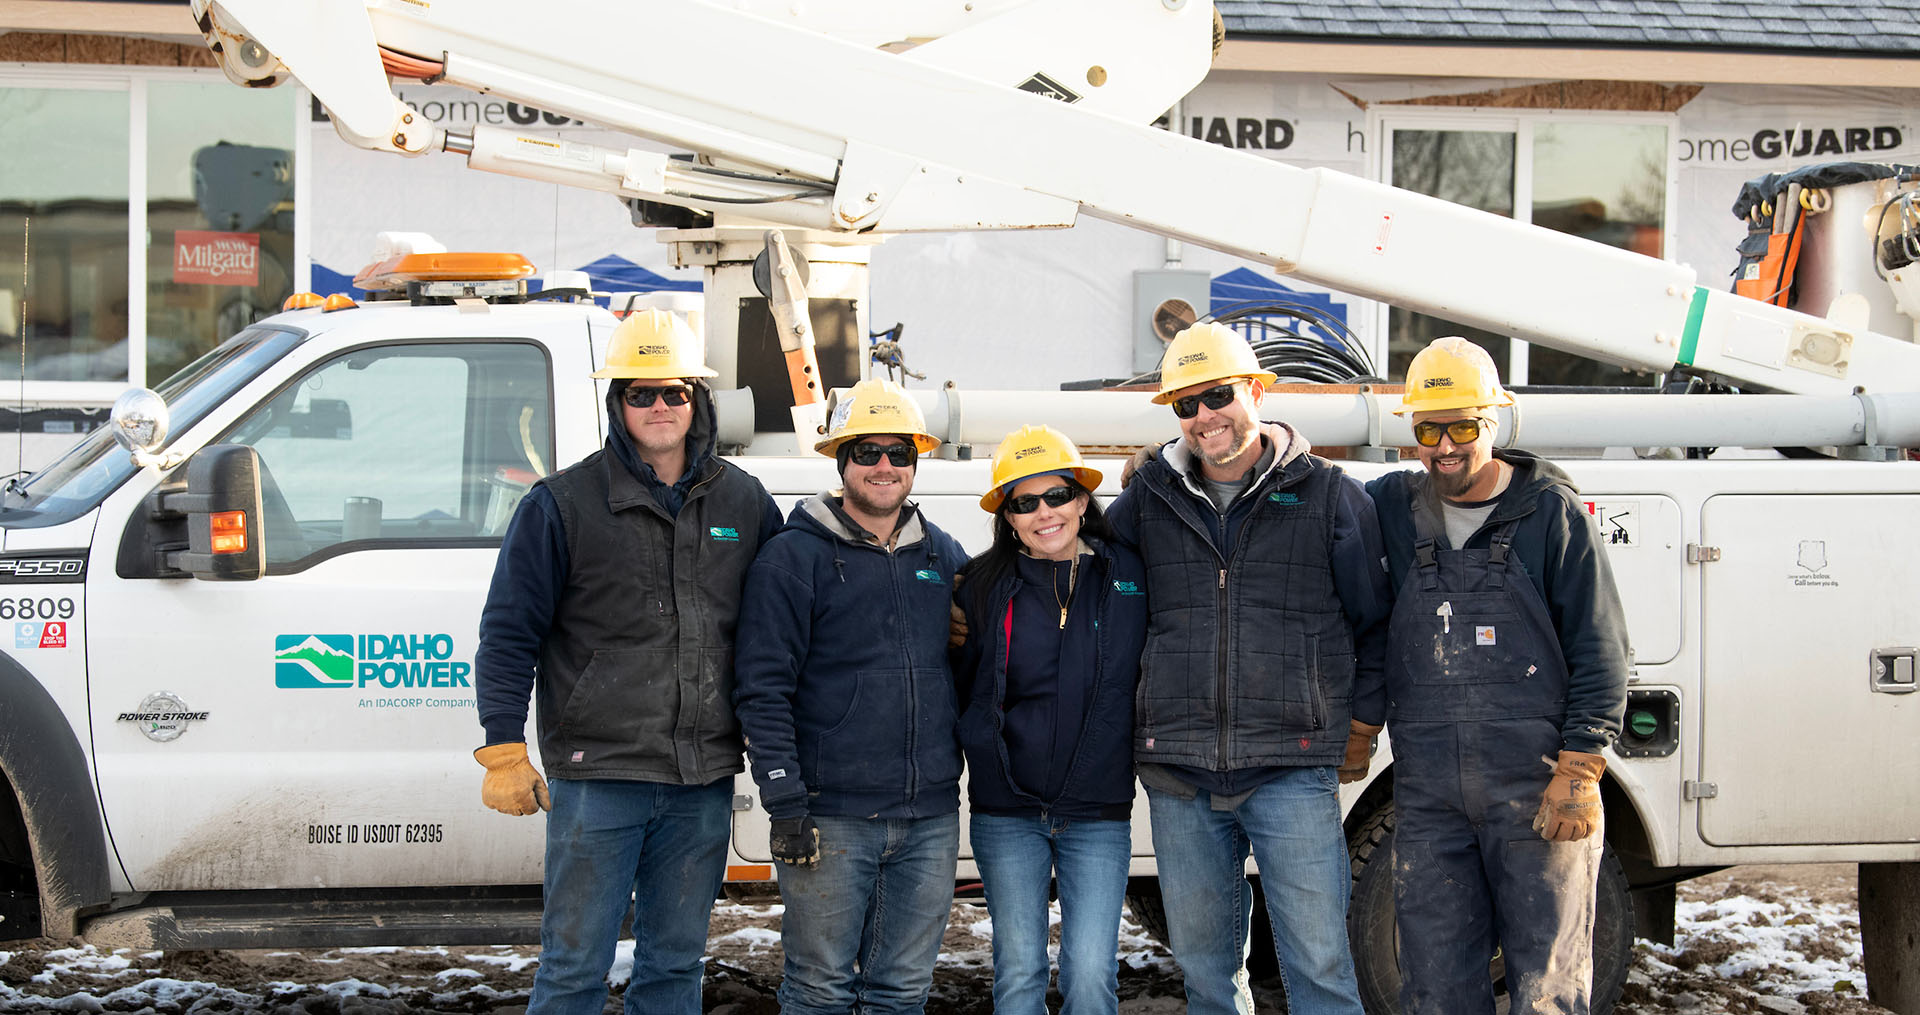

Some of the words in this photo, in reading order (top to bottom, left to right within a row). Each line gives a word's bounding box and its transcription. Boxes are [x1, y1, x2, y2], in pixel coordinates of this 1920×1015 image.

[178, 243, 257, 276] Milgard
[0, 597, 75, 619] 6809
[358, 633, 454, 661] IDAHO
[358, 661, 472, 689] POWER
[358, 698, 373, 708] An
[375, 698, 423, 708] IDACORP
[425, 698, 477, 710] Company
[117, 712, 161, 721] POWER
[161, 711, 210, 720] STROKE
[308, 824, 342, 844] BOISE
[347, 824, 359, 844] ID
[363, 823, 402, 844] USDOT
[405, 823, 443, 843] 62395
